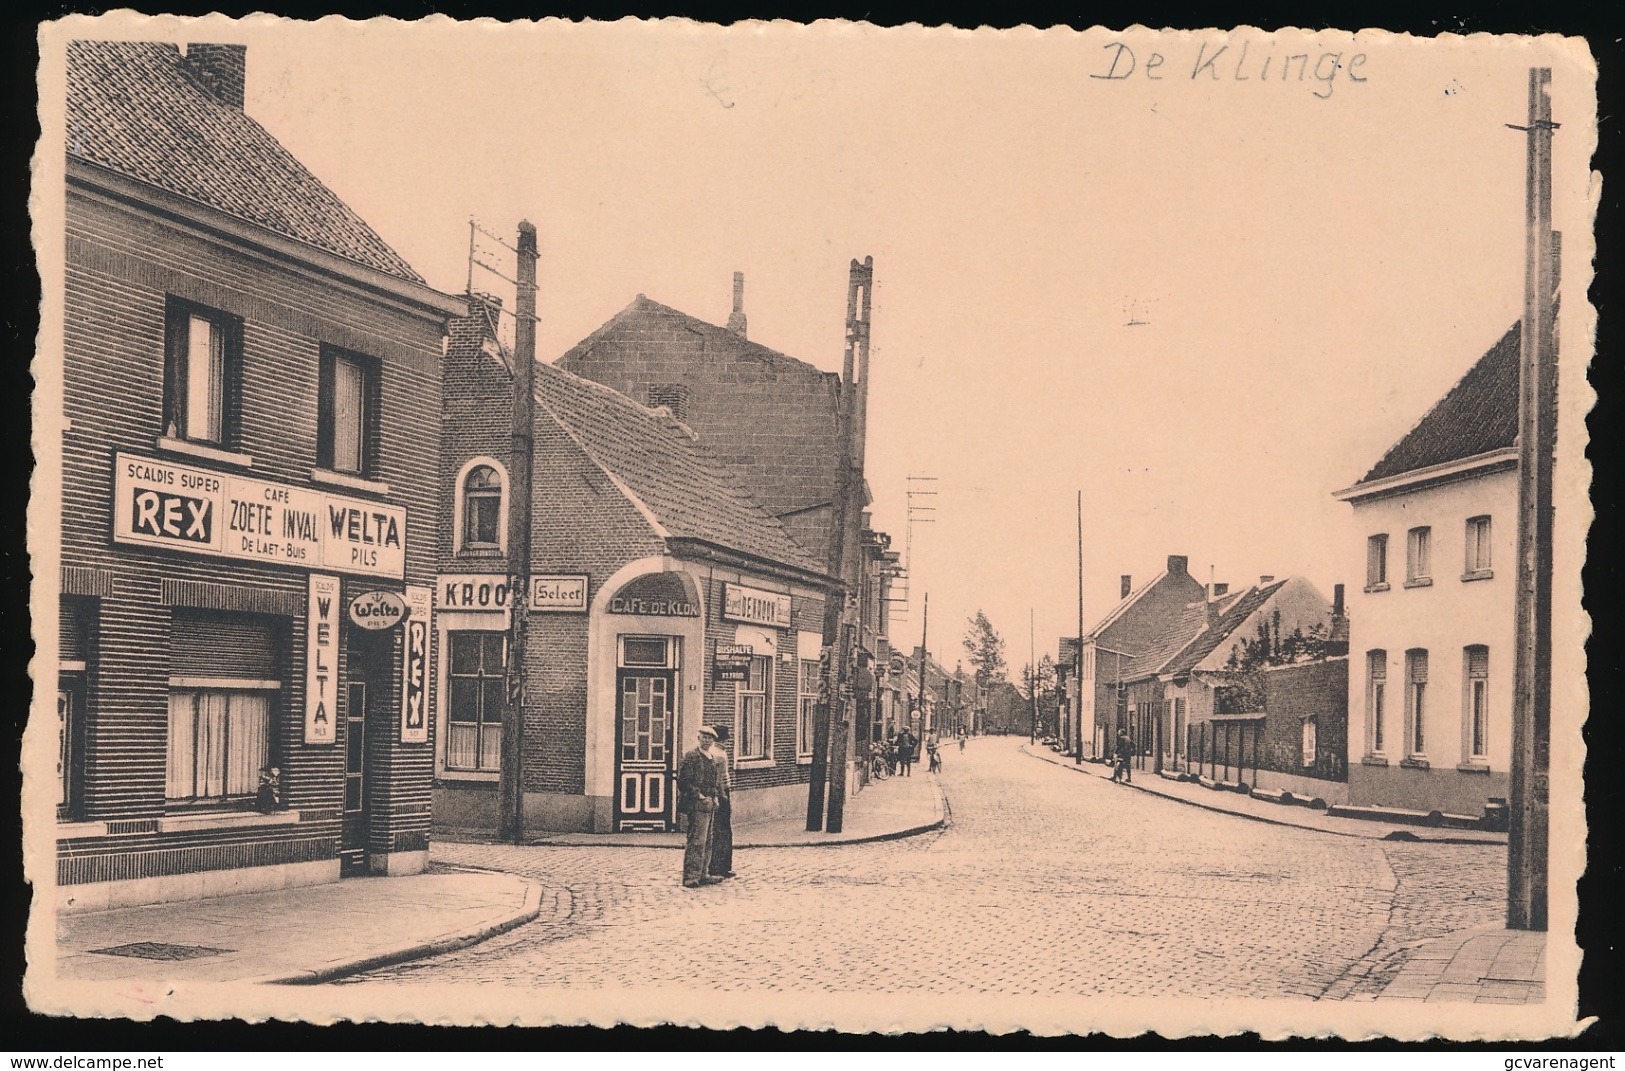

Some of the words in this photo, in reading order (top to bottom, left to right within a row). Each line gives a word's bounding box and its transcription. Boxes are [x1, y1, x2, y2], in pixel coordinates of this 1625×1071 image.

[1090, 42, 1165, 80] De
[1191, 40, 1368, 99] Klinge
[128, 463, 175, 485] SCALDIS
[181, 474, 220, 493] SUPER
[264, 487, 289, 504] CAFÉ
[136, 491, 209, 539] REX
[229, 499, 272, 536] ZOETE
[282, 508, 319, 543] INVAL
[329, 504, 401, 550] WELTA
[352, 548, 377, 566] PILS
[354, 601, 400, 617] Welta
[538, 585, 581, 600] Select
[314, 597, 331, 725] WELTA
[409, 622, 424, 726] REX
